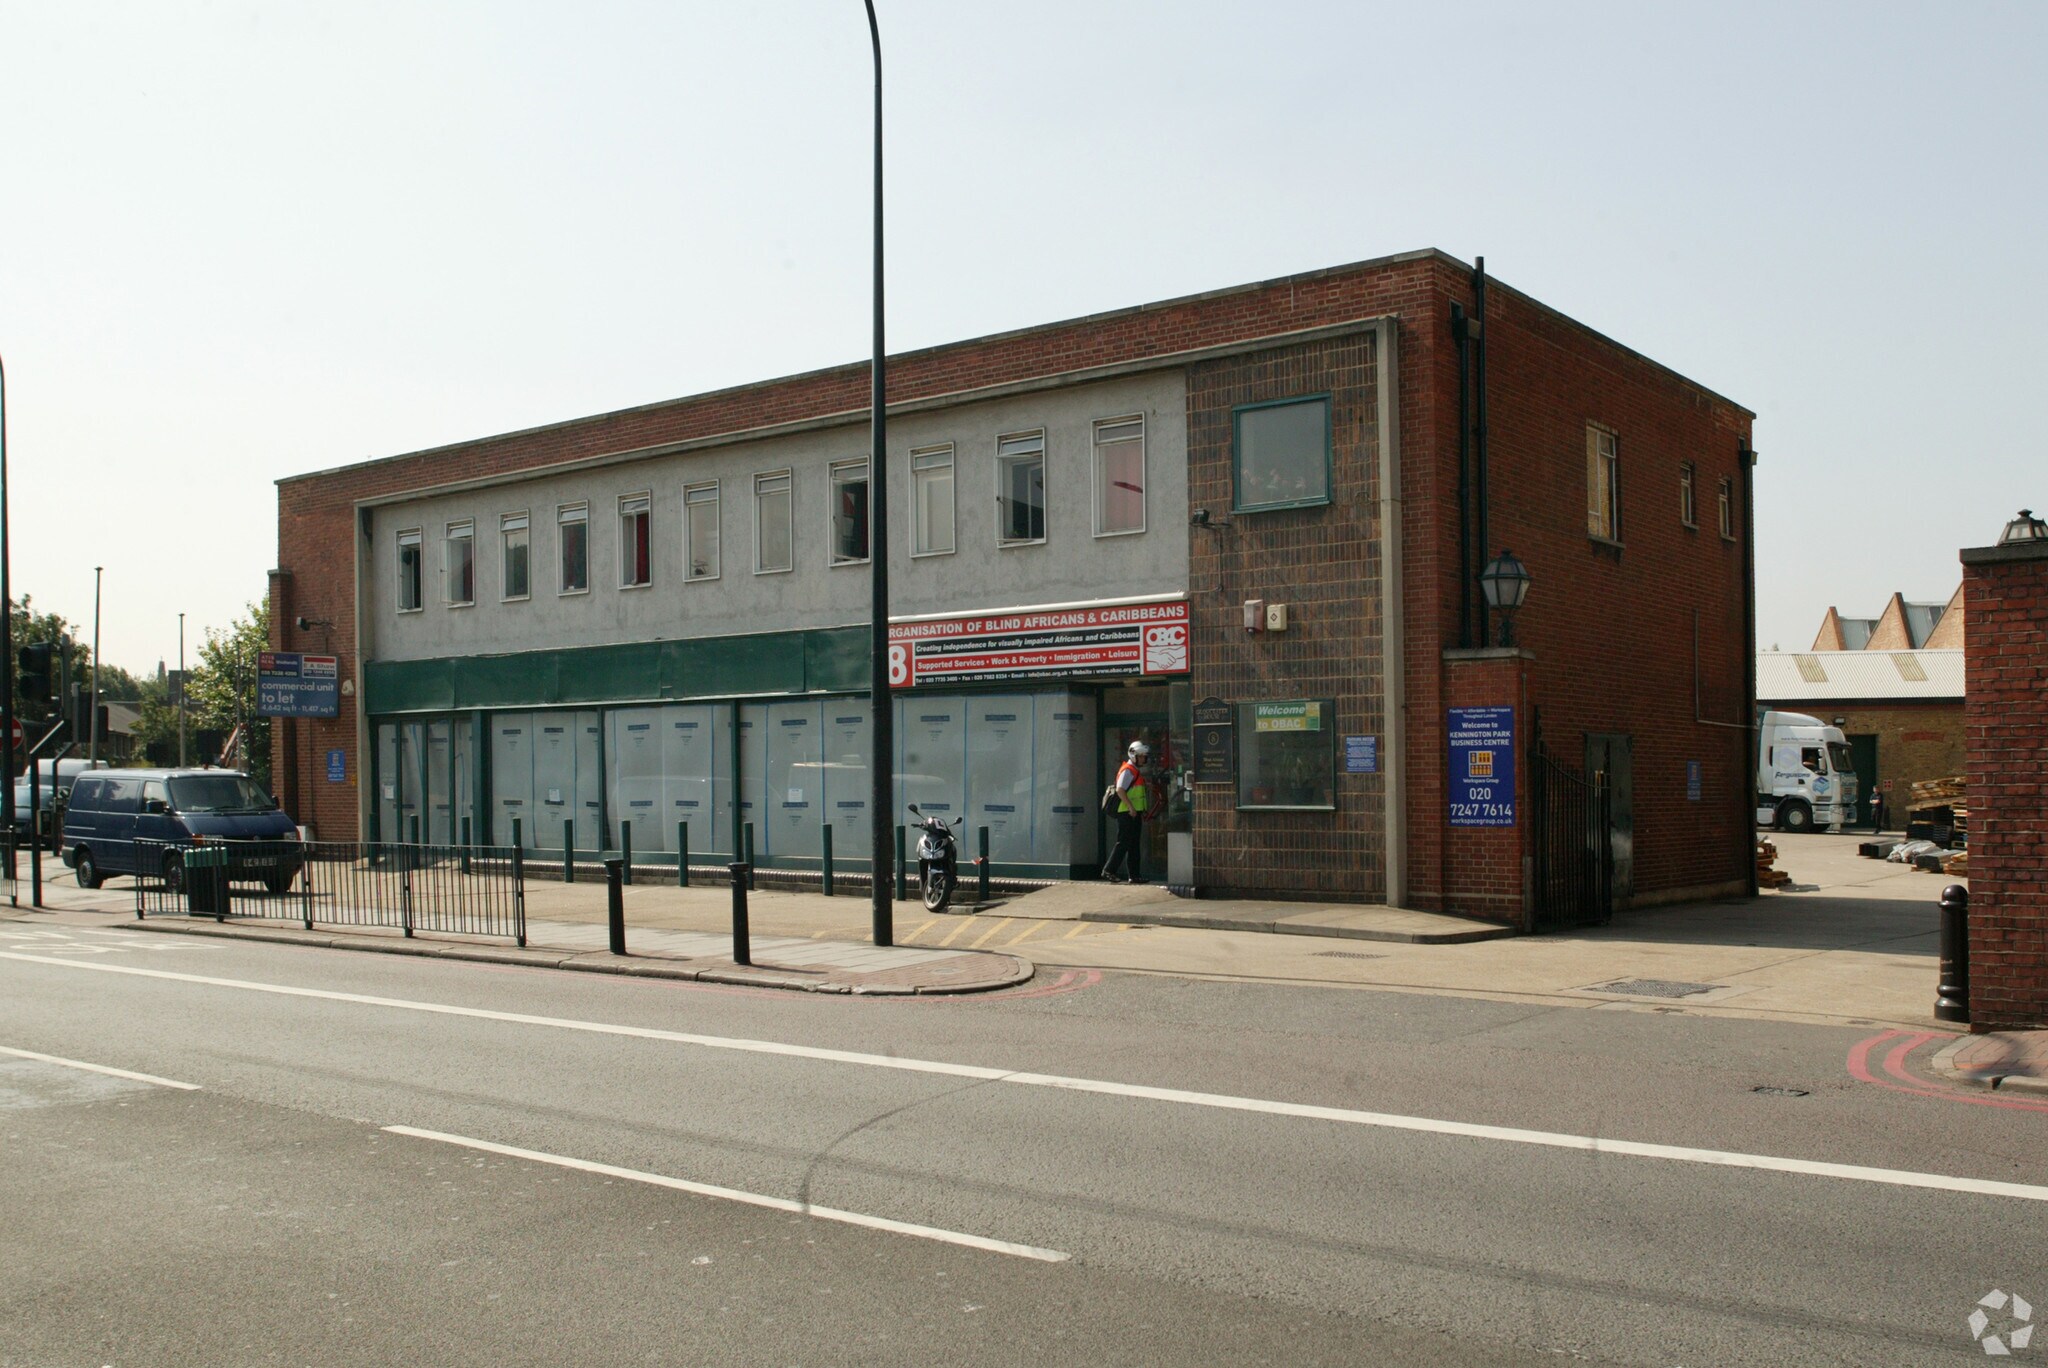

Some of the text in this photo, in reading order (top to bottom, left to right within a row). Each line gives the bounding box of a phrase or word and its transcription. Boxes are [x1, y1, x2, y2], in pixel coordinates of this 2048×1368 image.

[888, 605, 1185, 638] RGANISATION OF BLIND AFRICANS & CARIBBEANS
[916, 631, 1140, 653] Creating independence for visually impaired Africans and Caribbeans
[1145, 625, 1186, 647] OBAC
[917, 650, 1138, 670] Supported Services Work & Poverty Immigration Leisure
[261, 681, 335, 692] commercial unit
[261, 690, 295, 704] to let
[282, 705, 291, 713] sq
[291, 704, 298, 712] ft
[320, 706, 329, 714] sq
[1258, 705, 1306, 716] Welcome
[1256, 719, 1302, 729] to OBAC
[1449, 730, 1511, 739] KENNINGTON PARK
[1450, 738, 1510, 747] BUSINESS CENTRE
[1469, 787, 1492, 800] 020
[1450, 803, 1513, 816] 7247 7614
[1450, 817, 1513, 826] workspacegroup.co.uk
